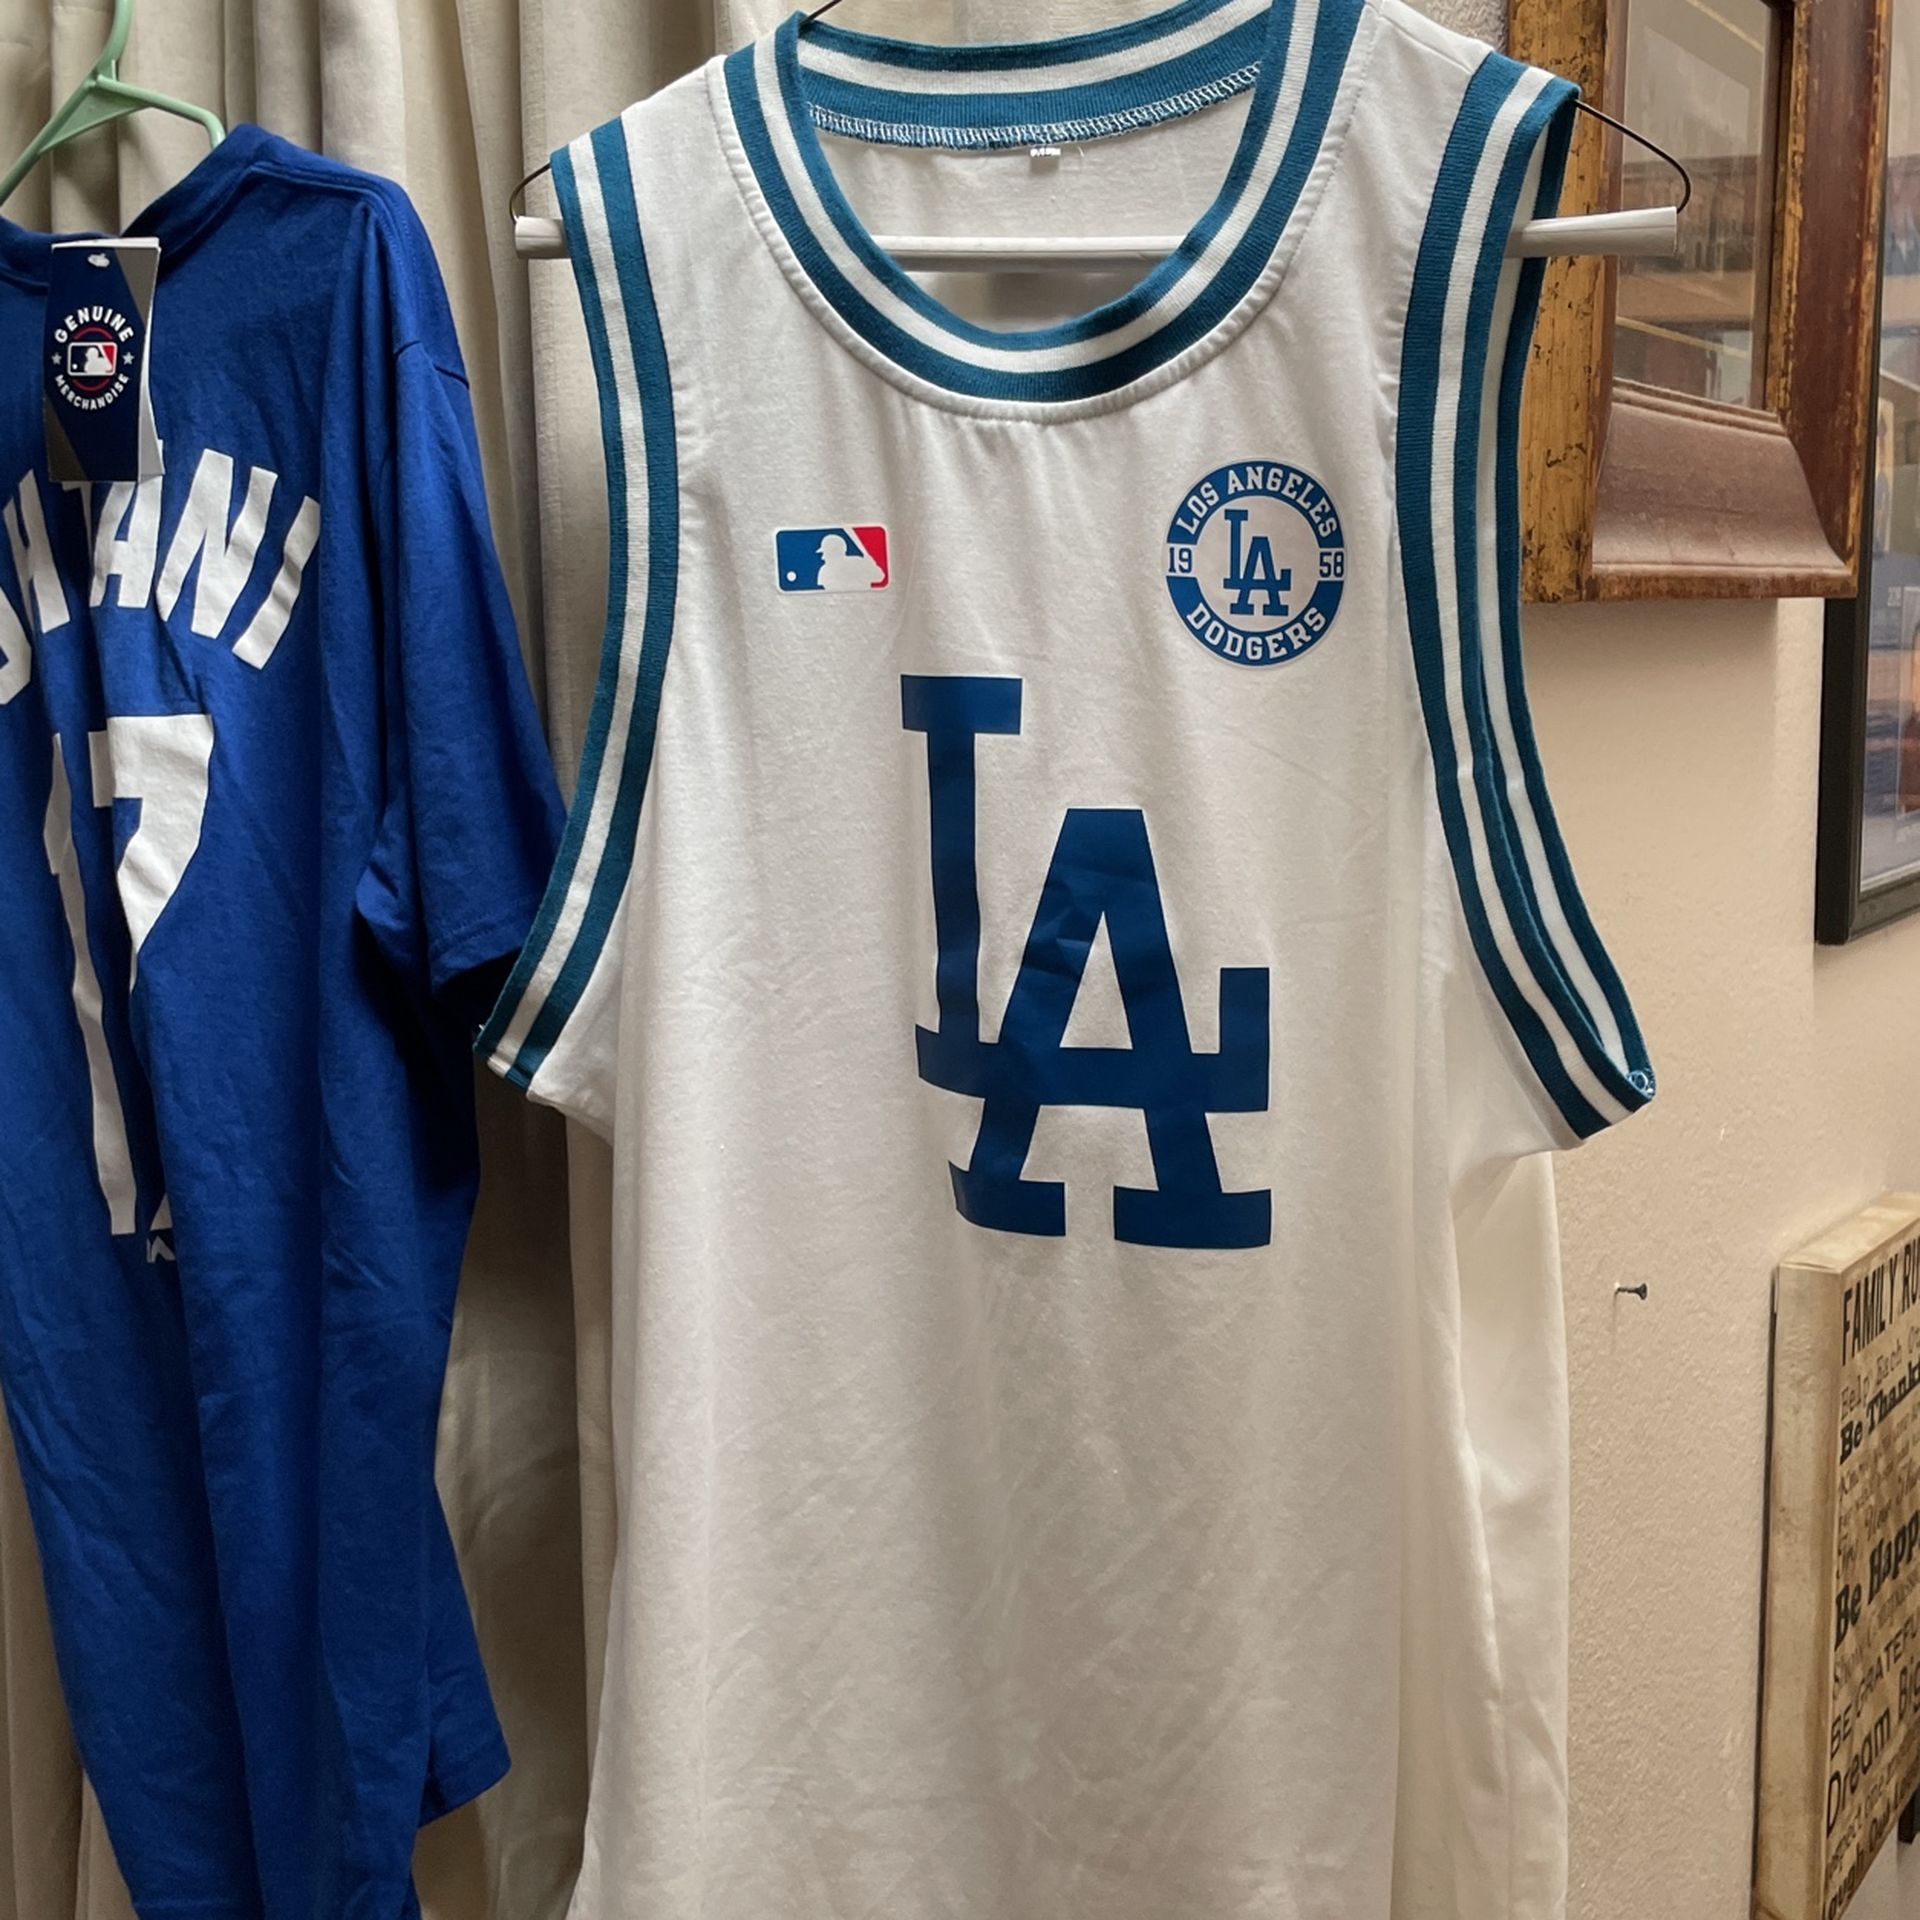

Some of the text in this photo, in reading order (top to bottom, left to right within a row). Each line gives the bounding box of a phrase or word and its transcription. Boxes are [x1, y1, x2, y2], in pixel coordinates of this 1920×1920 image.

[54, 306, 134, 343] GENUINE
[54, 373, 130, 411] MERCHANDISE
[1176, 466, 1337, 538] LOS ANGELES
[1168, 547, 1192, 574] 19
[1223, 509, 1291, 616] LA
[1319, 551, 1344, 578] 58
[1186, 603, 1326, 660] DODGERS
[900, 674, 1272, 1249] LA
[1842, 1236, 1920, 1366] FAMILY RU
[1840, 1419, 1863, 1465] Be
[1866, 1357, 1920, 1435] Thank
[1834, 1583, 1862, 1651] Be
[1868, 1509, 1920, 1605] Happ
[1830, 1703, 1852, 1760] BE
[1826, 1707, 1890, 1838] Dream
